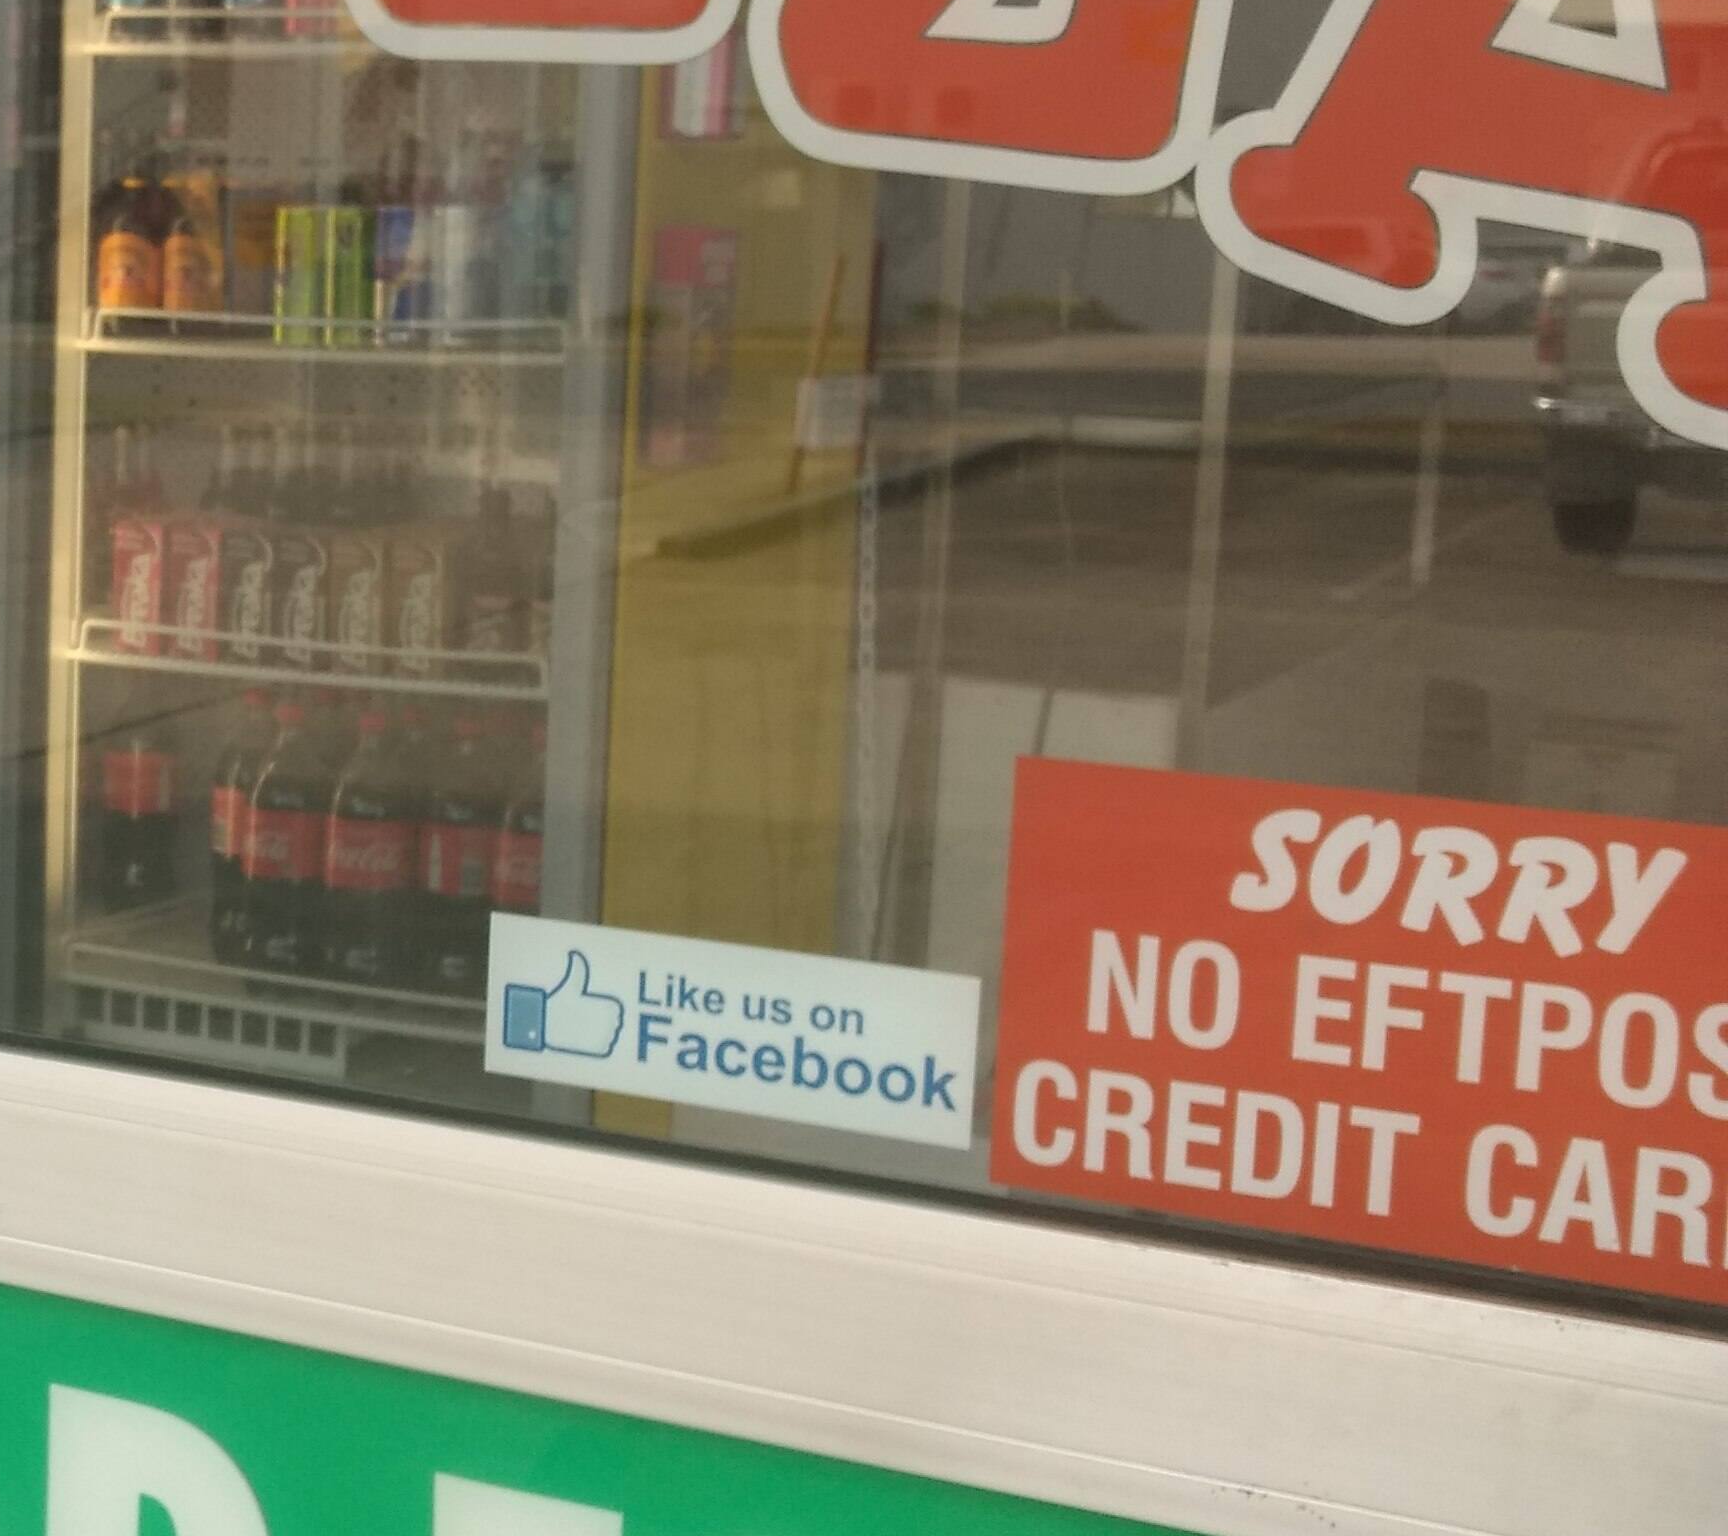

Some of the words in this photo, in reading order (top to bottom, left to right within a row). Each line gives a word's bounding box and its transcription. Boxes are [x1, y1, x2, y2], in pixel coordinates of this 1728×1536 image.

[1229, 807, 1688, 959] SORRY
[637, 971, 726, 1015] Like
[741, 993, 793, 1026] us
[808, 1004, 864, 1036] on
[1086, 928, 1241, 1051] NO
[636, 1013, 958, 1113] Facebook
[1012, 1058, 1421, 1218] CREDIT
[1464, 1123, 1728, 1270] CAR
